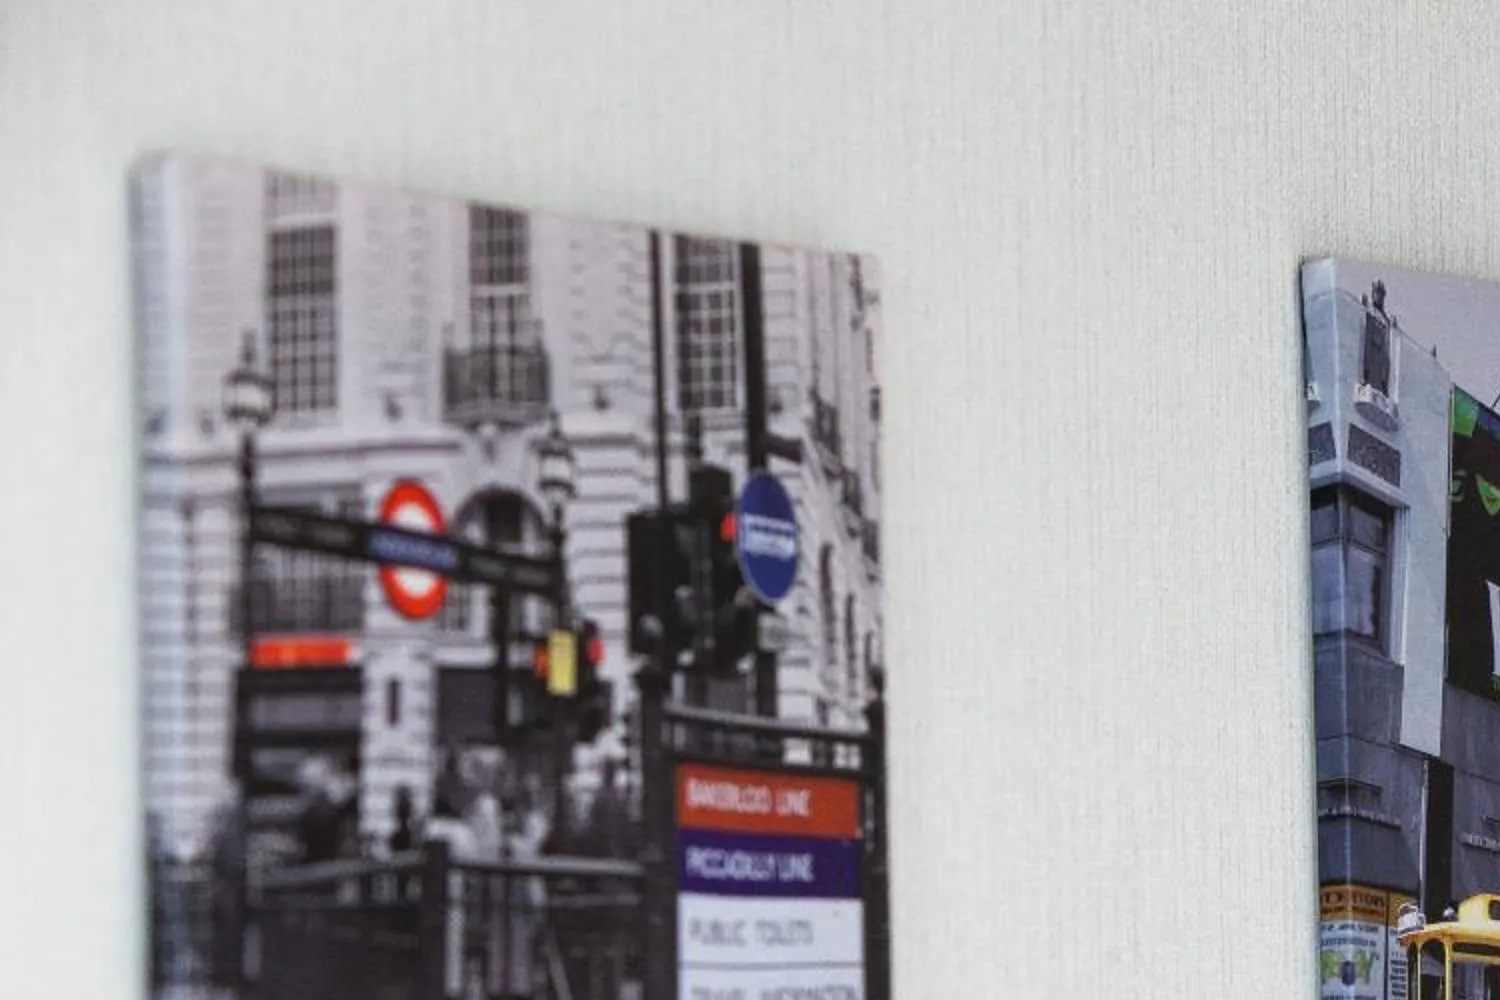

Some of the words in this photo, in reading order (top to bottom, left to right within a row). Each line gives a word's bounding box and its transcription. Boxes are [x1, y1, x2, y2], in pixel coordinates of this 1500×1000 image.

[686, 777, 772, 815] BAKERLOO
[775, 788, 811, 816] LINE
[686, 846, 775, 881] PICCADILLY
[778, 853, 814, 882] LINE
[688, 917, 748, 947] PUBLIC
